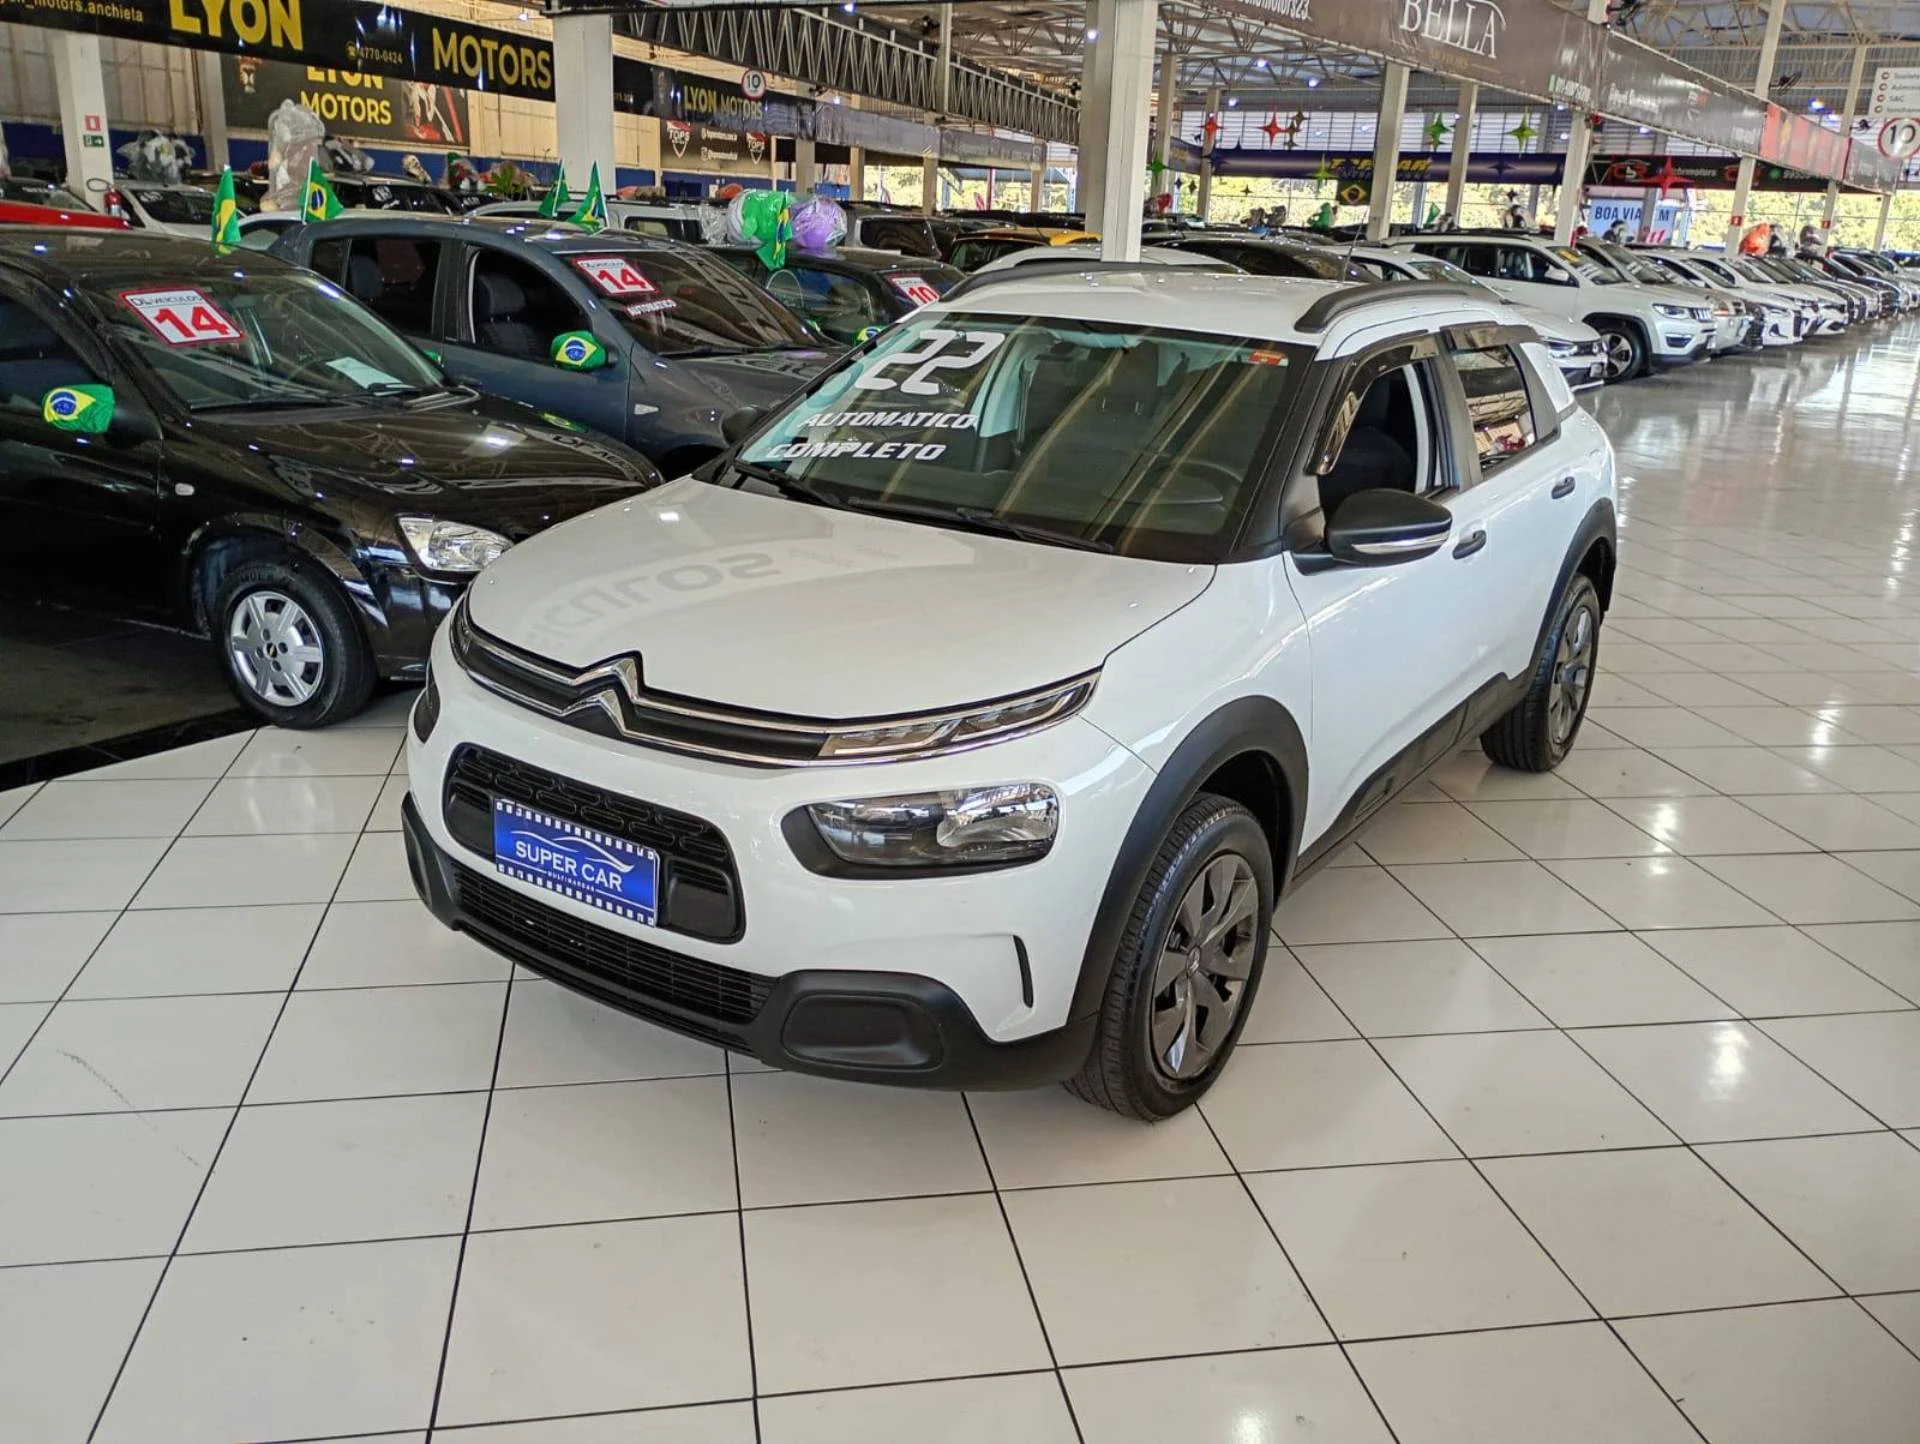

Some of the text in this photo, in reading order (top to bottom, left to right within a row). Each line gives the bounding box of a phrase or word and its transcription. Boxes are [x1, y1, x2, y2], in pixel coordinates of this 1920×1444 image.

[1400, 0, 1497, 59] BELLA
[170, 0, 552, 90] LYON MOTORS
[747, 73, 761, 90] 10
[300, 90, 392, 126] MOTORS
[683, 85, 762, 120] LYON MOTORS
[668, 128, 691, 143] TOPS
[1888, 123, 1917, 145] 10
[1594, 206, 1619, 221] BOA
[597, 268, 647, 290] 14
[908, 286, 938, 304] 10
[154, 305, 230, 338] 14
[854, 329, 1005, 395] 22
[765, 443, 947, 460] COMPLETO
[515, 840, 623, 893] SUPER CAR
